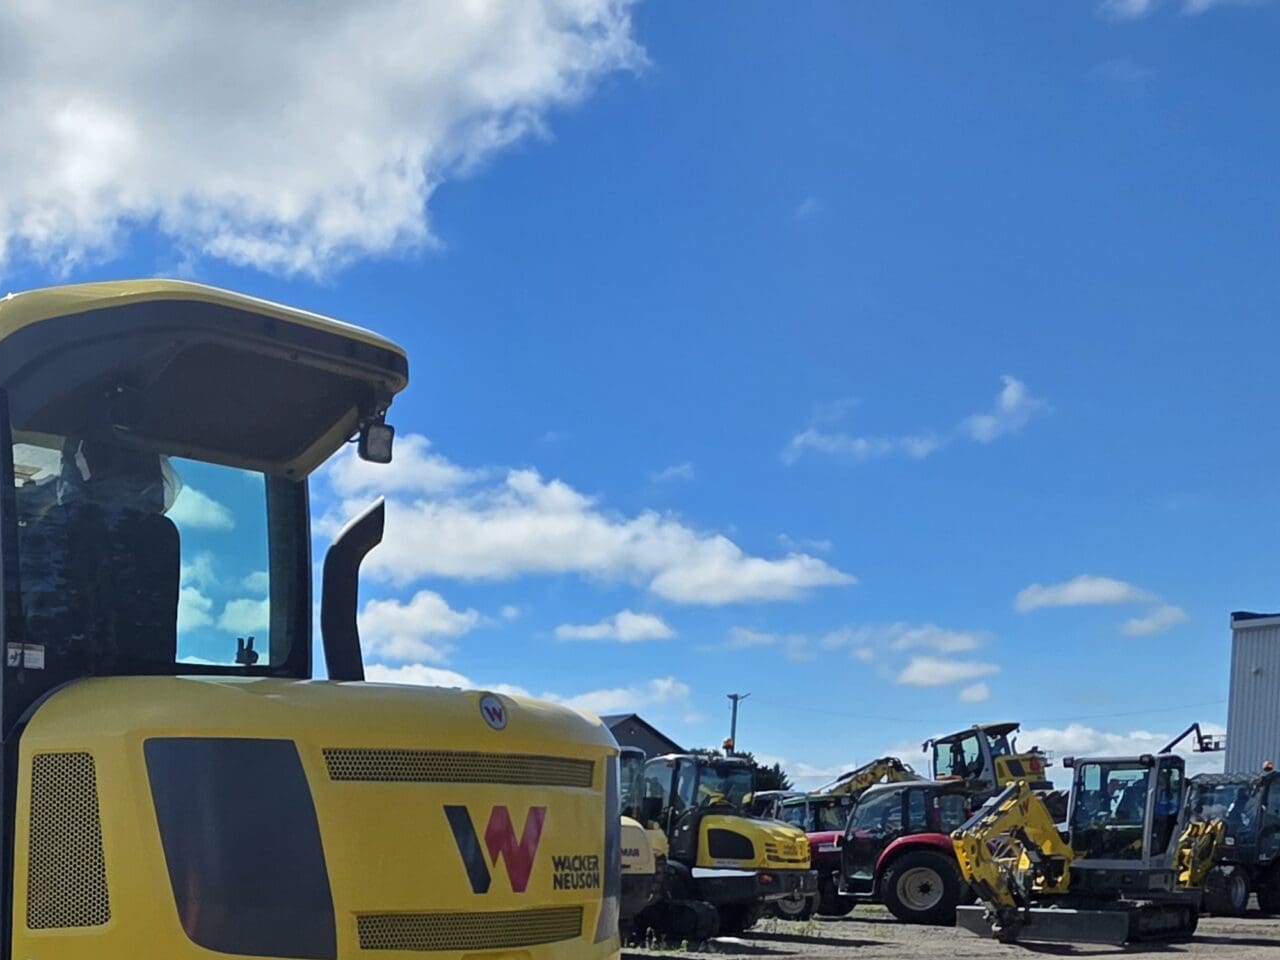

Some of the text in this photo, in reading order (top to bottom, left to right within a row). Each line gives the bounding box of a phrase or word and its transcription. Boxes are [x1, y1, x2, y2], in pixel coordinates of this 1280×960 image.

[443, 805, 547, 894] W
[552, 855, 600, 872] WACKER
[553, 873, 600, 890] NEUSON
